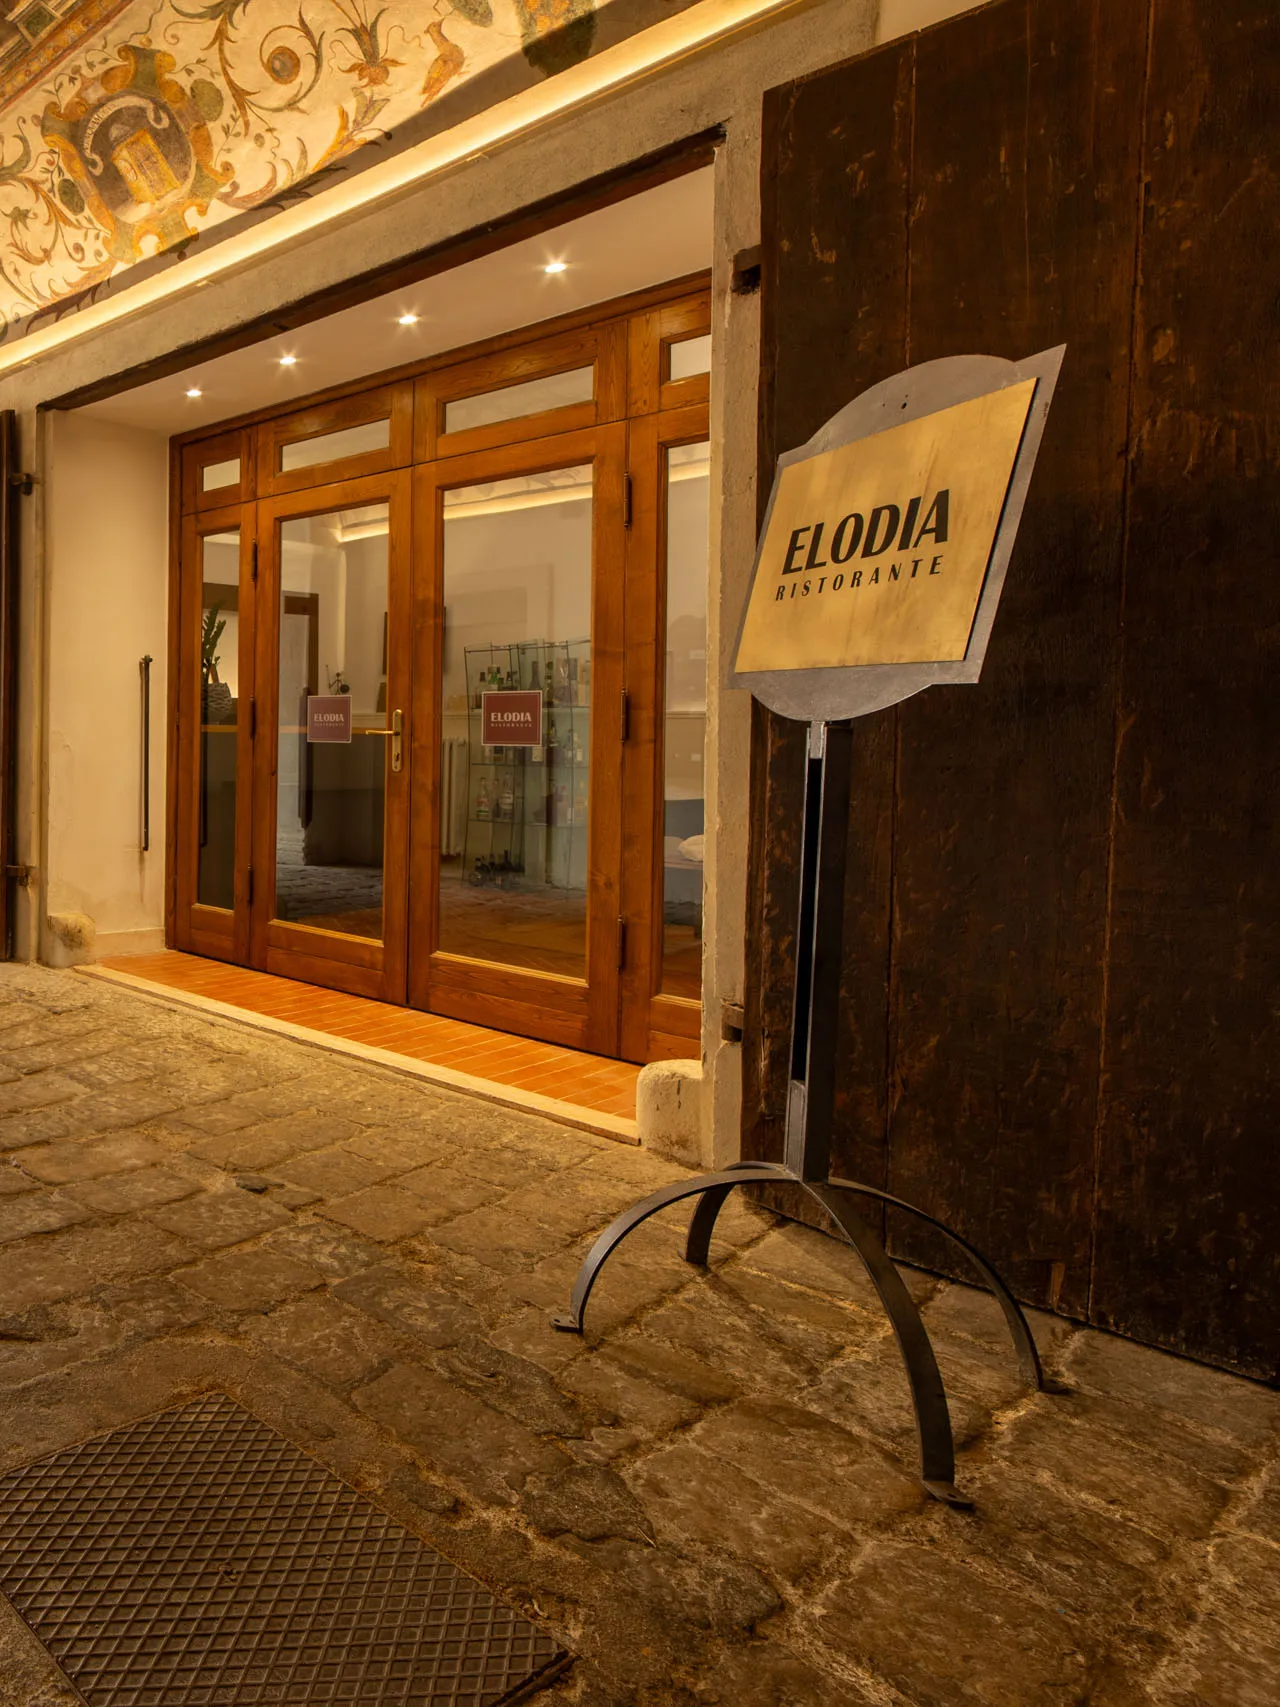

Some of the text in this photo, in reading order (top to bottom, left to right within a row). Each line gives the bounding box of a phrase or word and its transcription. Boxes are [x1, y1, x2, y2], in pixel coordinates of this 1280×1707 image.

[781, 489, 950, 576] ELODIA
[775, 555, 944, 601] RISTORANTE
[313, 713, 345, 722] ELODIA
[490, 711, 532, 722] ELODIA
